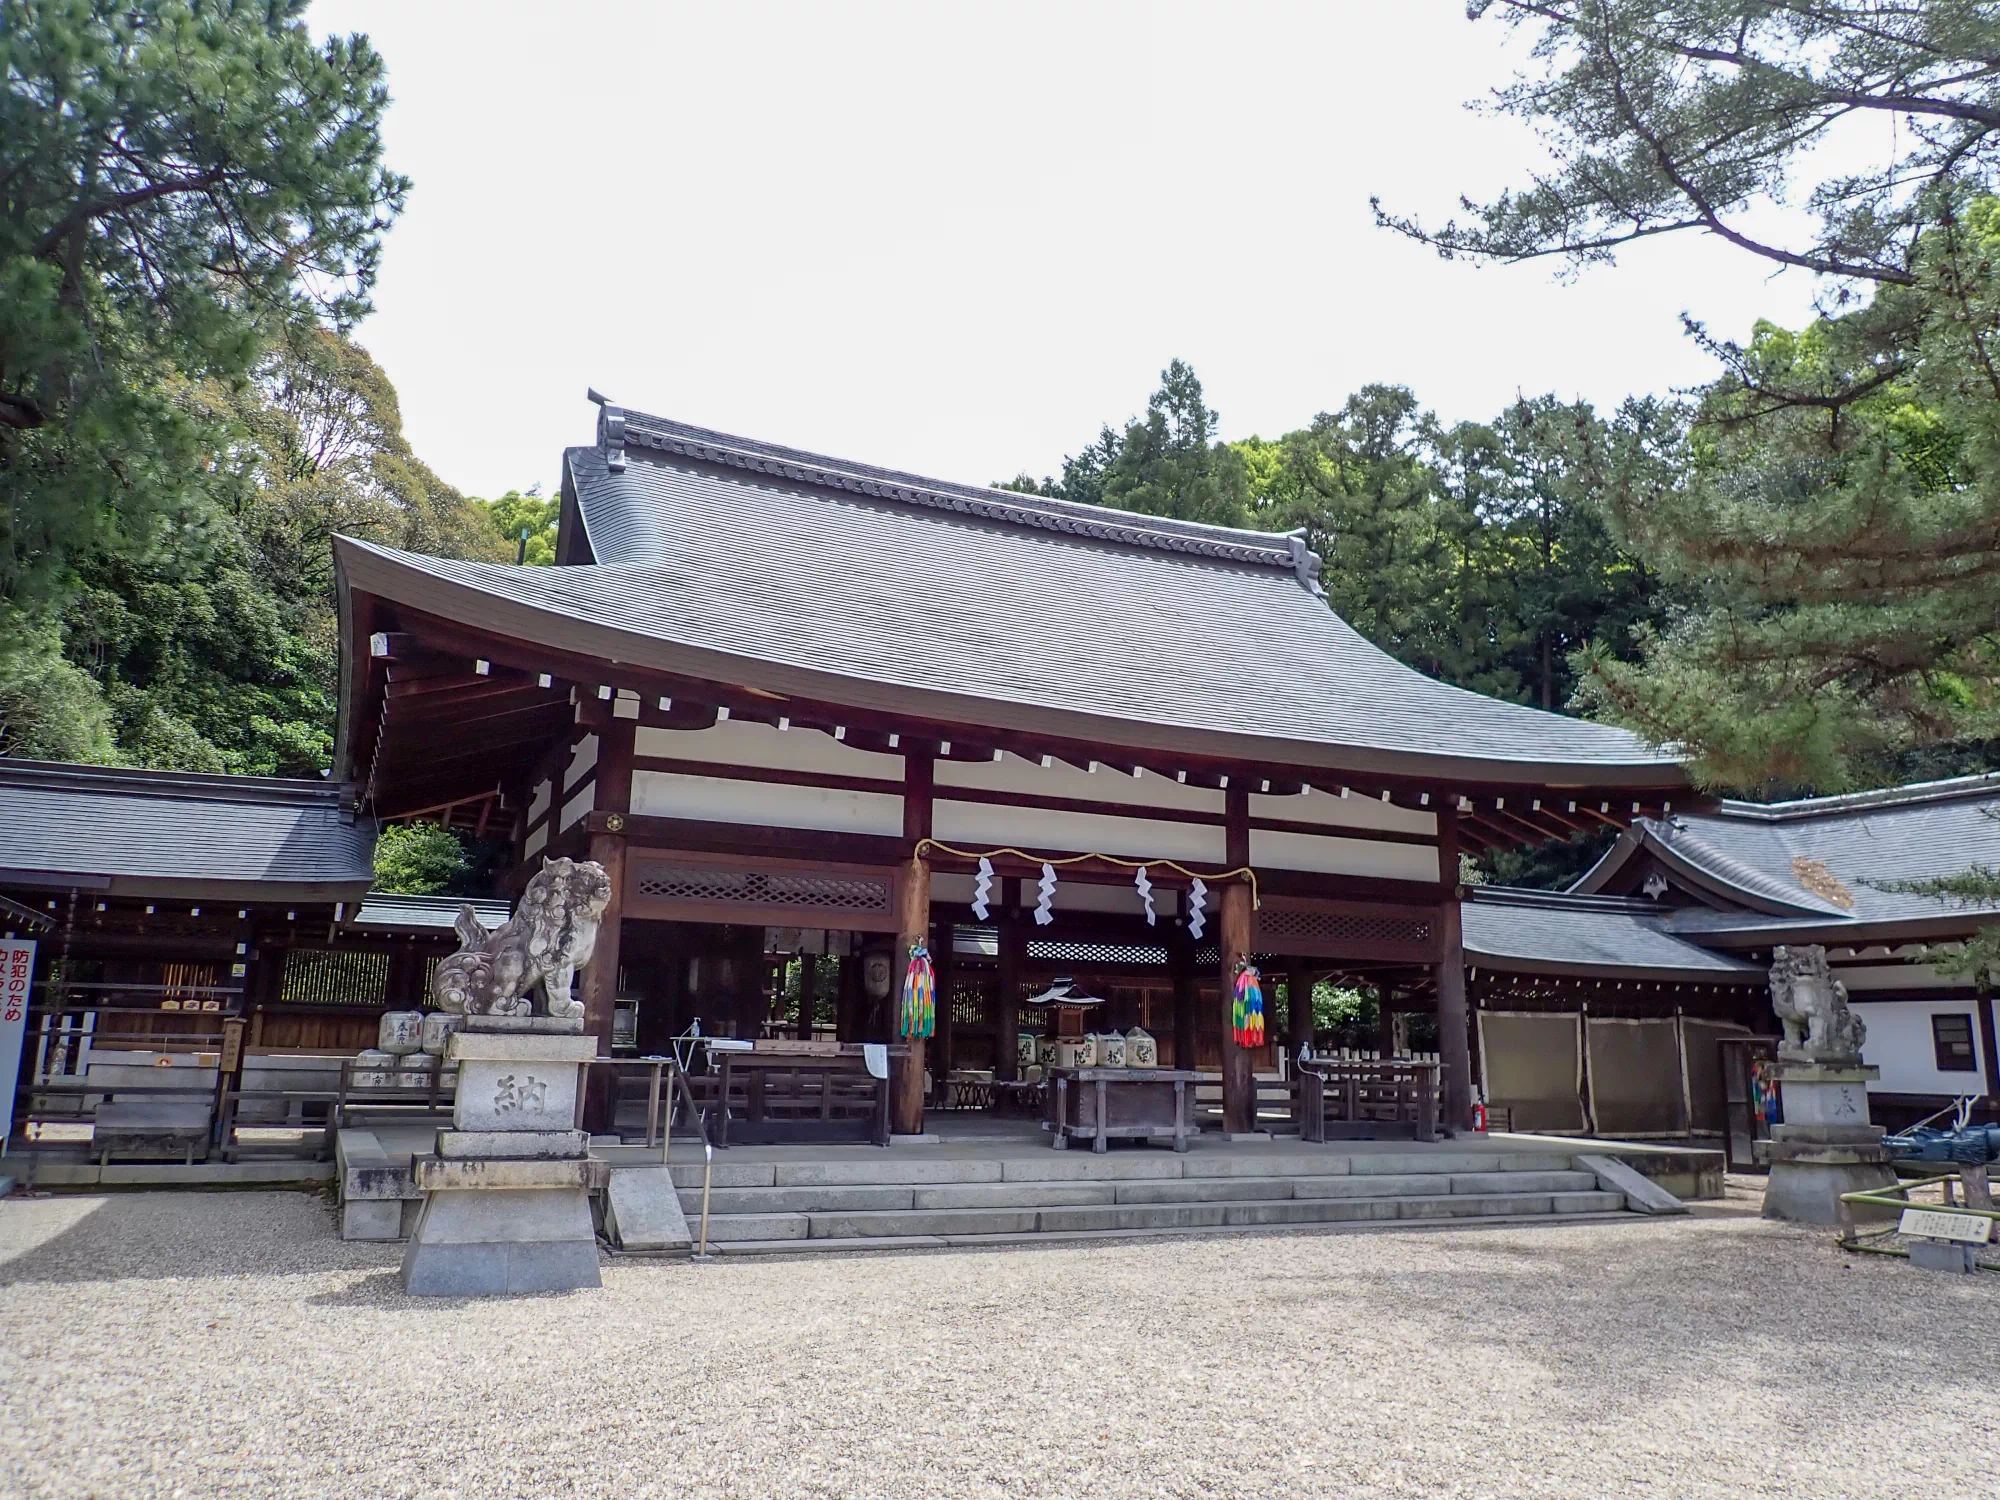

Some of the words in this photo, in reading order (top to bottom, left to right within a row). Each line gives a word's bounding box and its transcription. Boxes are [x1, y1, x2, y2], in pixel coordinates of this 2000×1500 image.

[4, 949, 30, 1022] 防犯のため
[494, 1074, 547, 1117] 納
[1833, 1085, 1857, 1120] 奉
